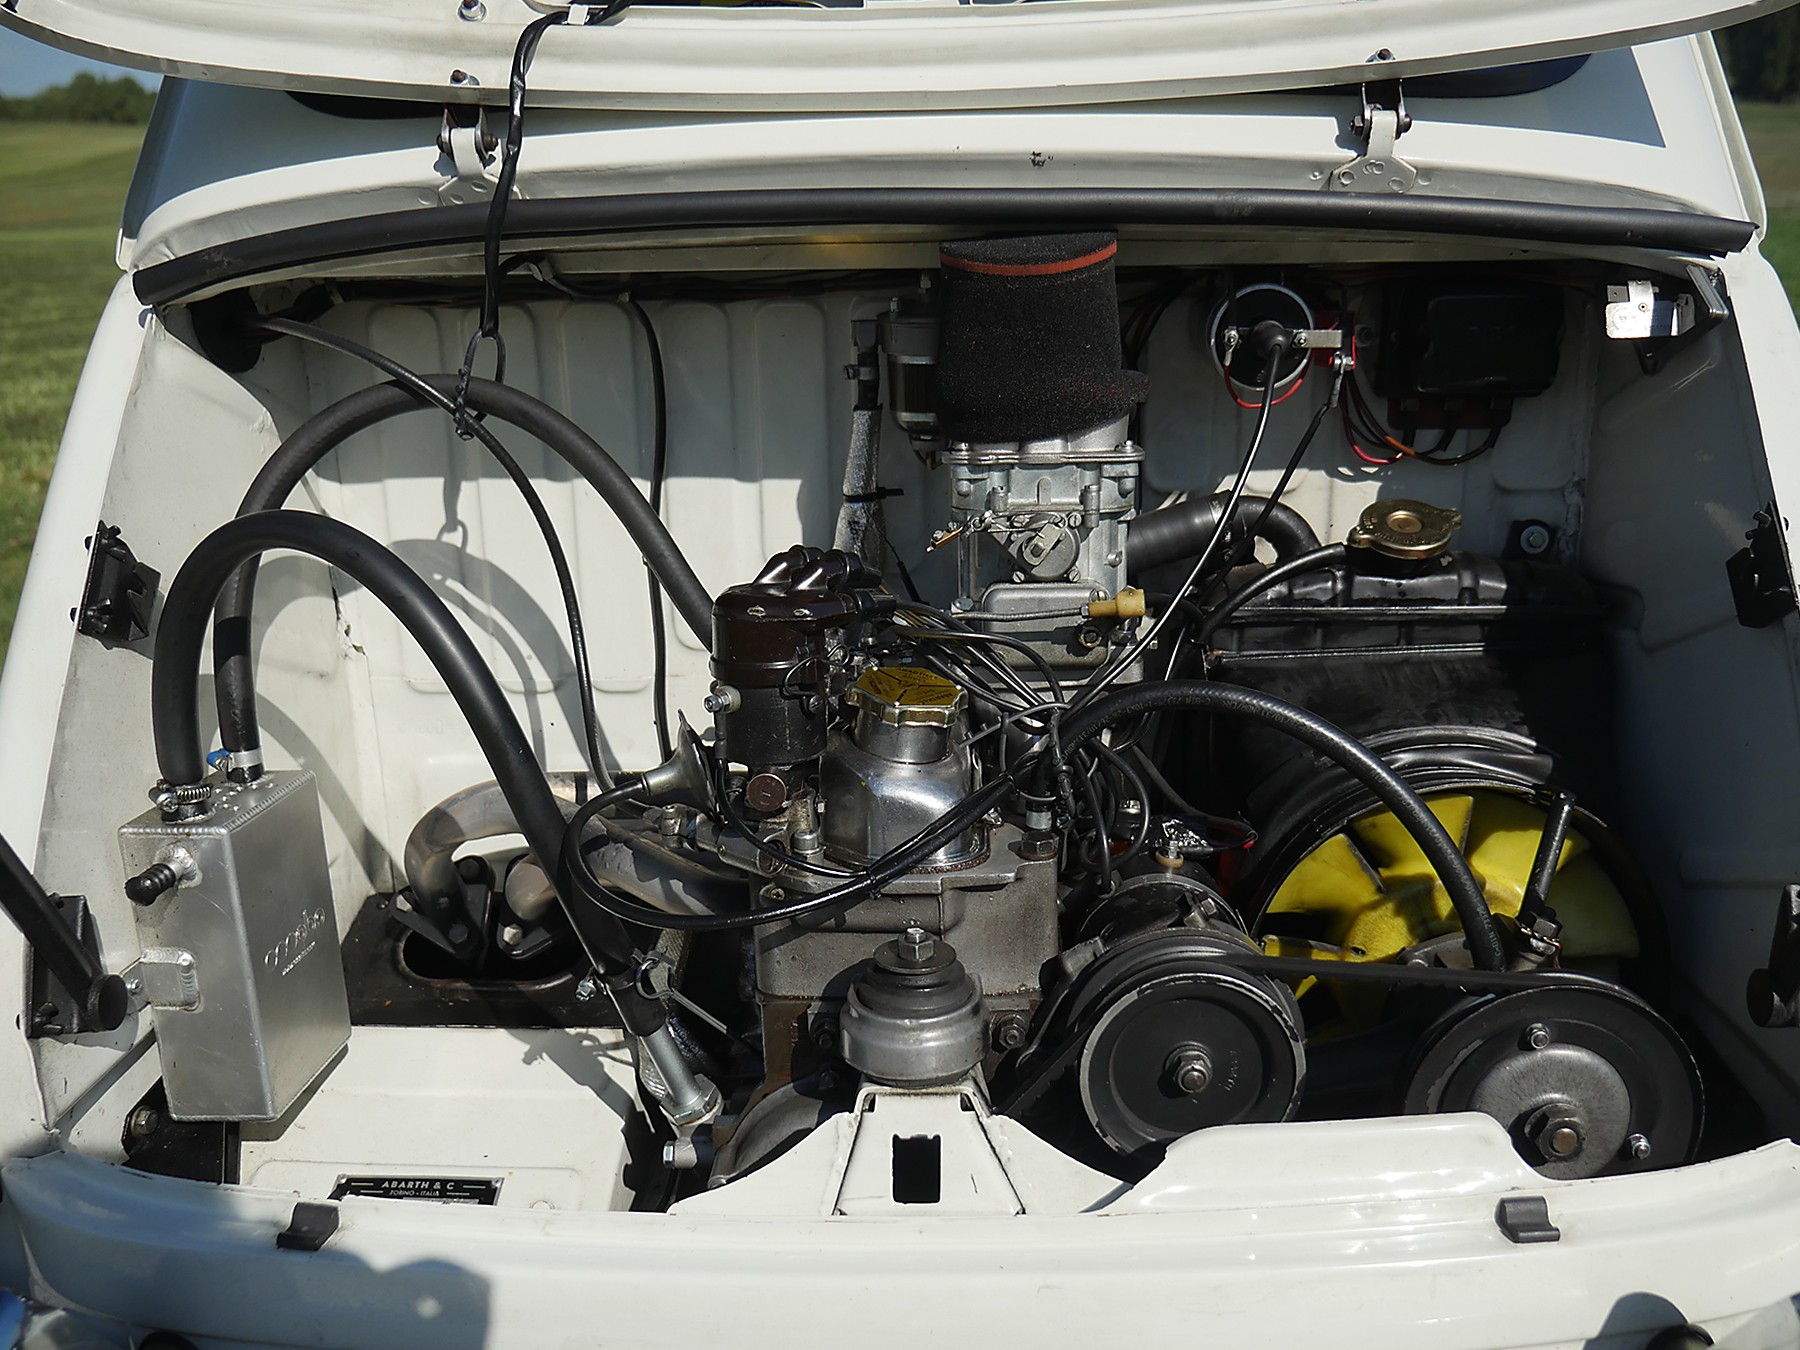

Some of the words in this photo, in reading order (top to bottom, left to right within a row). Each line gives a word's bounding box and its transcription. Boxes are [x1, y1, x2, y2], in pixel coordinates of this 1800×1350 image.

[381, 1180, 430, 1189] ABARTH
[433, 1181, 441, 1189] &
[446, 1182, 455, 1190] C
